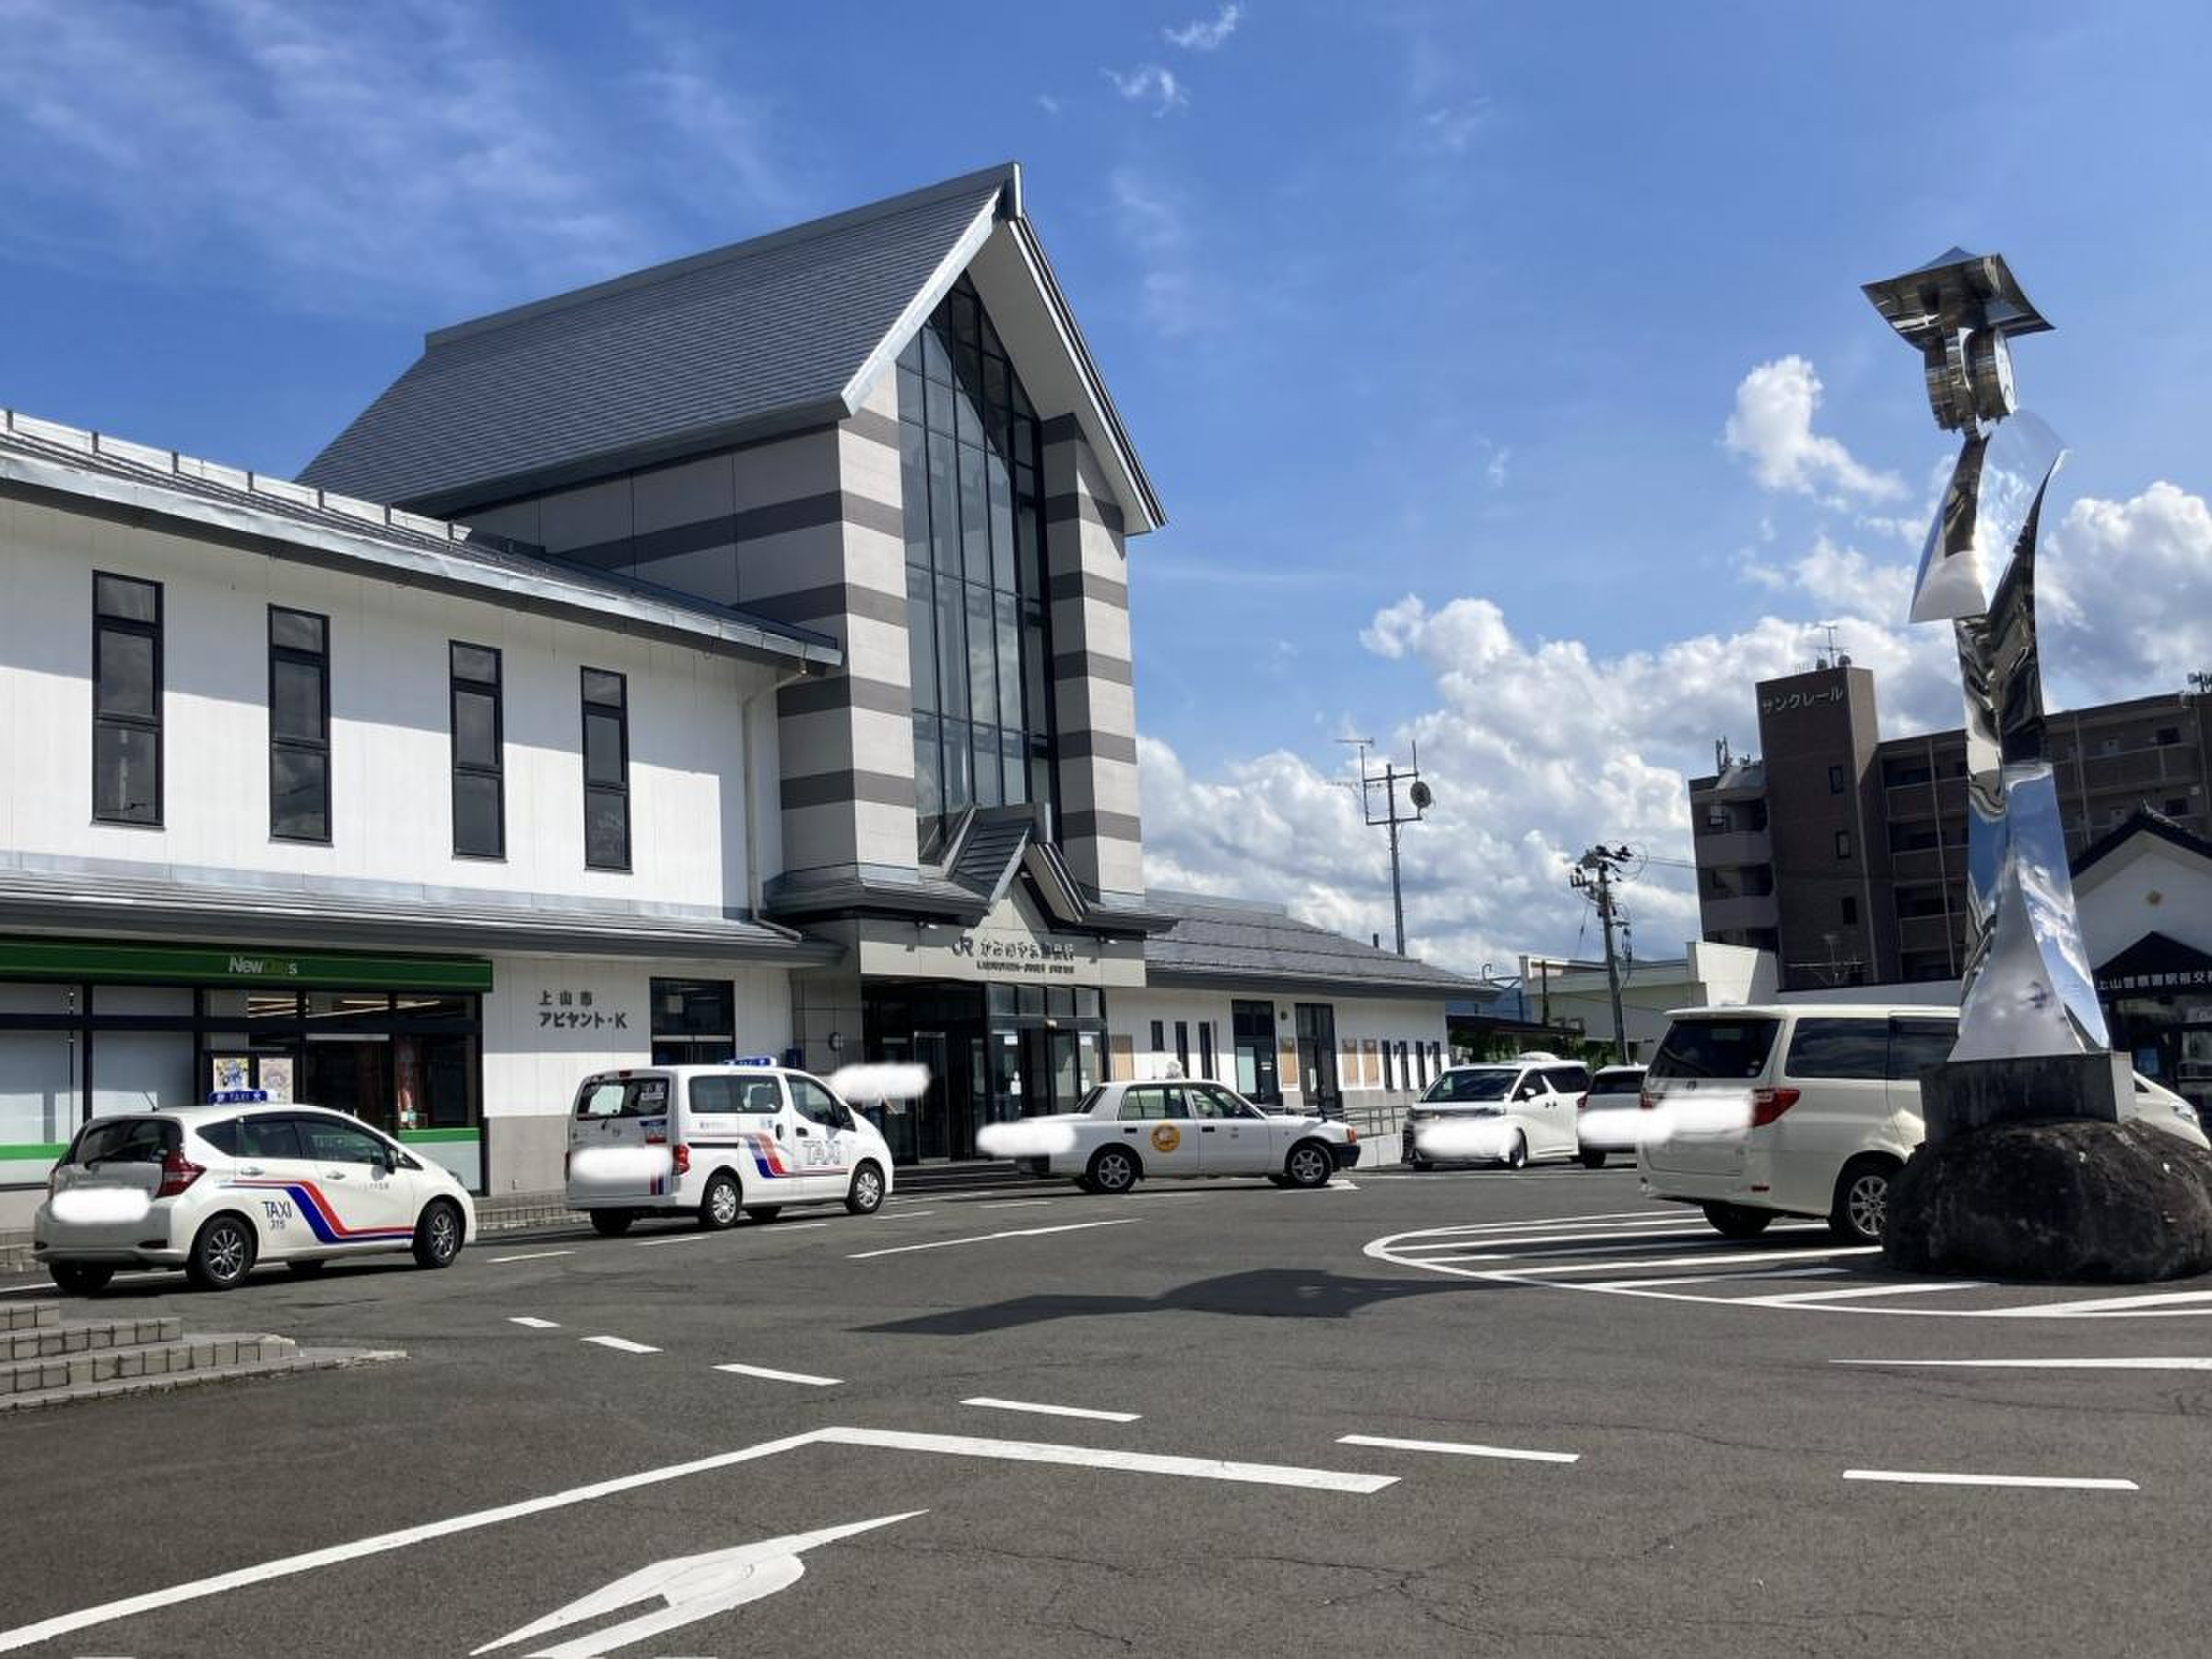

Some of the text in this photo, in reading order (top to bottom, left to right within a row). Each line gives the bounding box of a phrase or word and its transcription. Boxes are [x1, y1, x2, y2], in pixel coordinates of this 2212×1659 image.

[1762, 686, 1843, 713] サンクレール
[952, 935, 973, 957] JR
[262, 1201, 292, 1218] TAXI
